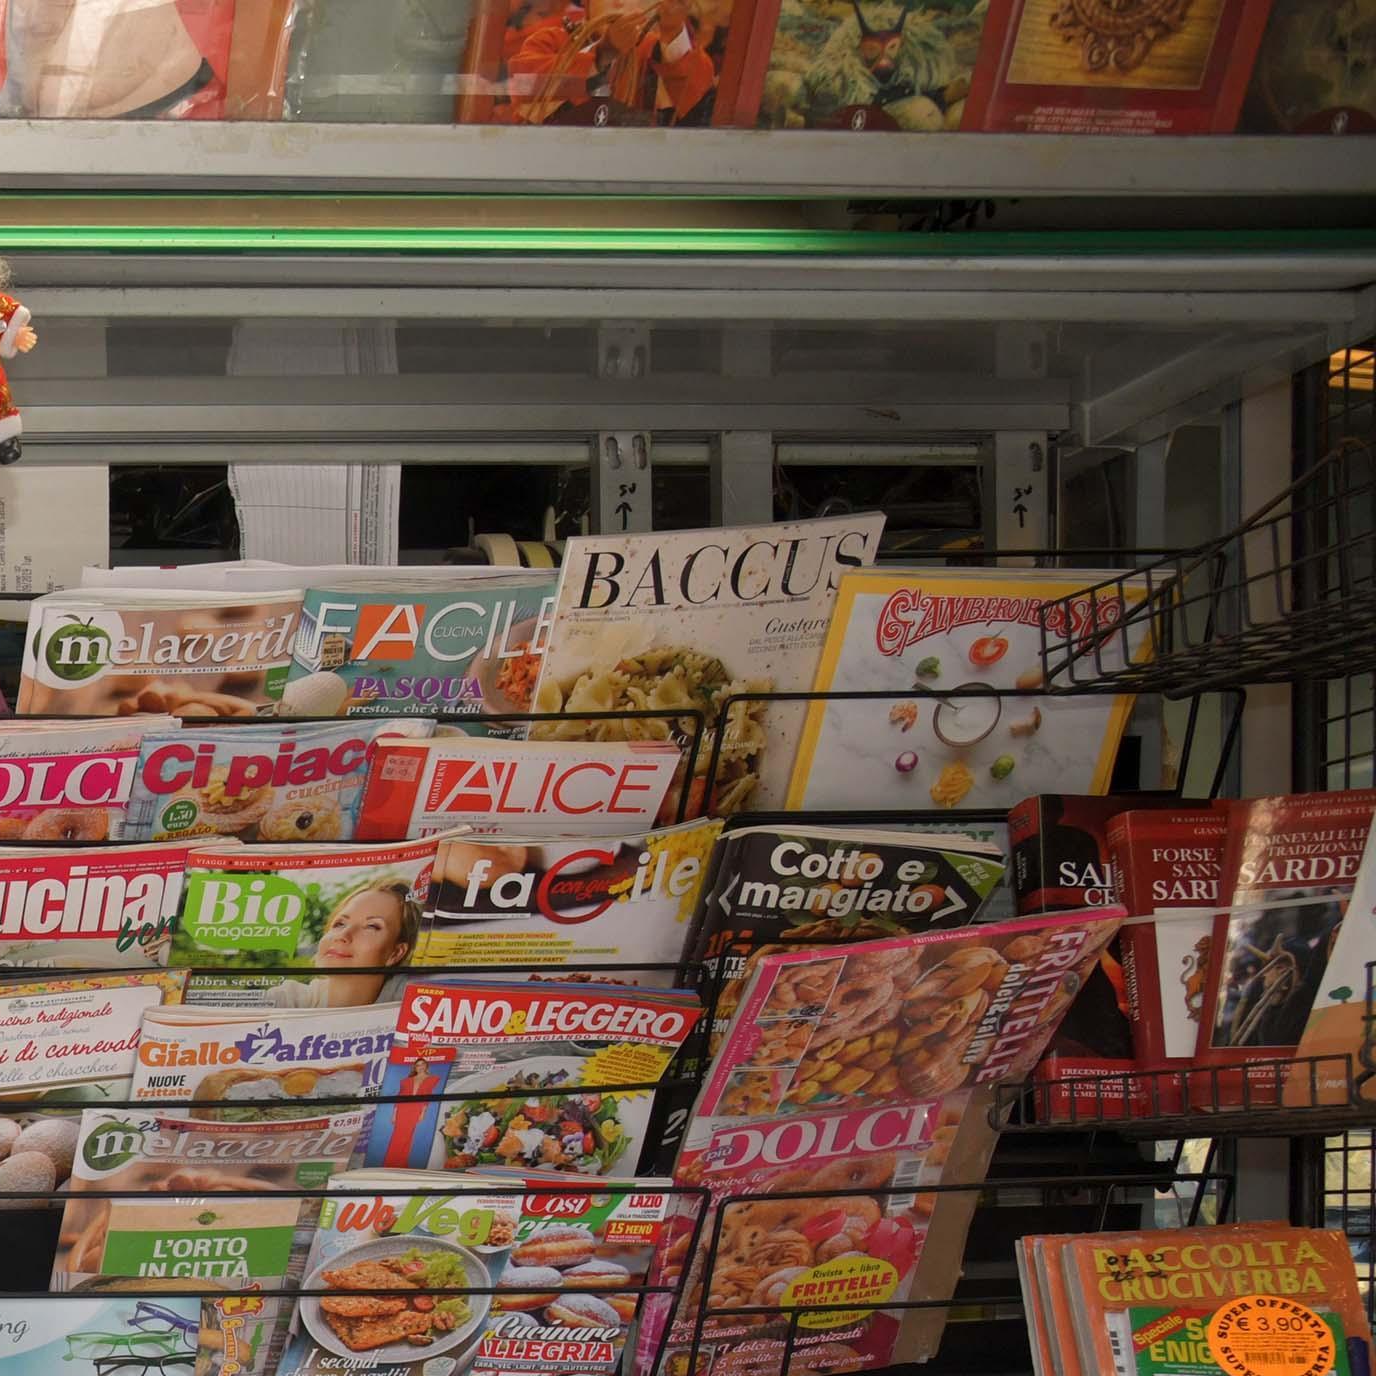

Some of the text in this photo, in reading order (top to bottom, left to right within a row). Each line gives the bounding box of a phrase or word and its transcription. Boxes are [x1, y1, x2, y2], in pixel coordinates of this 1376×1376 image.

[577, 529, 871, 612] BACCUS
[351, 675, 483, 700] PASQUA
[768, 840, 925, 886] Cotto e
[197, 881, 302, 926] Bio
[737, 877, 934, 918] mangiato
[195, 924, 291, 941] magazine
[153, 1238, 247, 1261] L'ORTO
[1094, 1241, 1326, 1273] RACCOLTA
[1098, 1267, 1327, 1301] CRUCIVERBA
[1237, 1317, 1303, 1333] € 3,90
